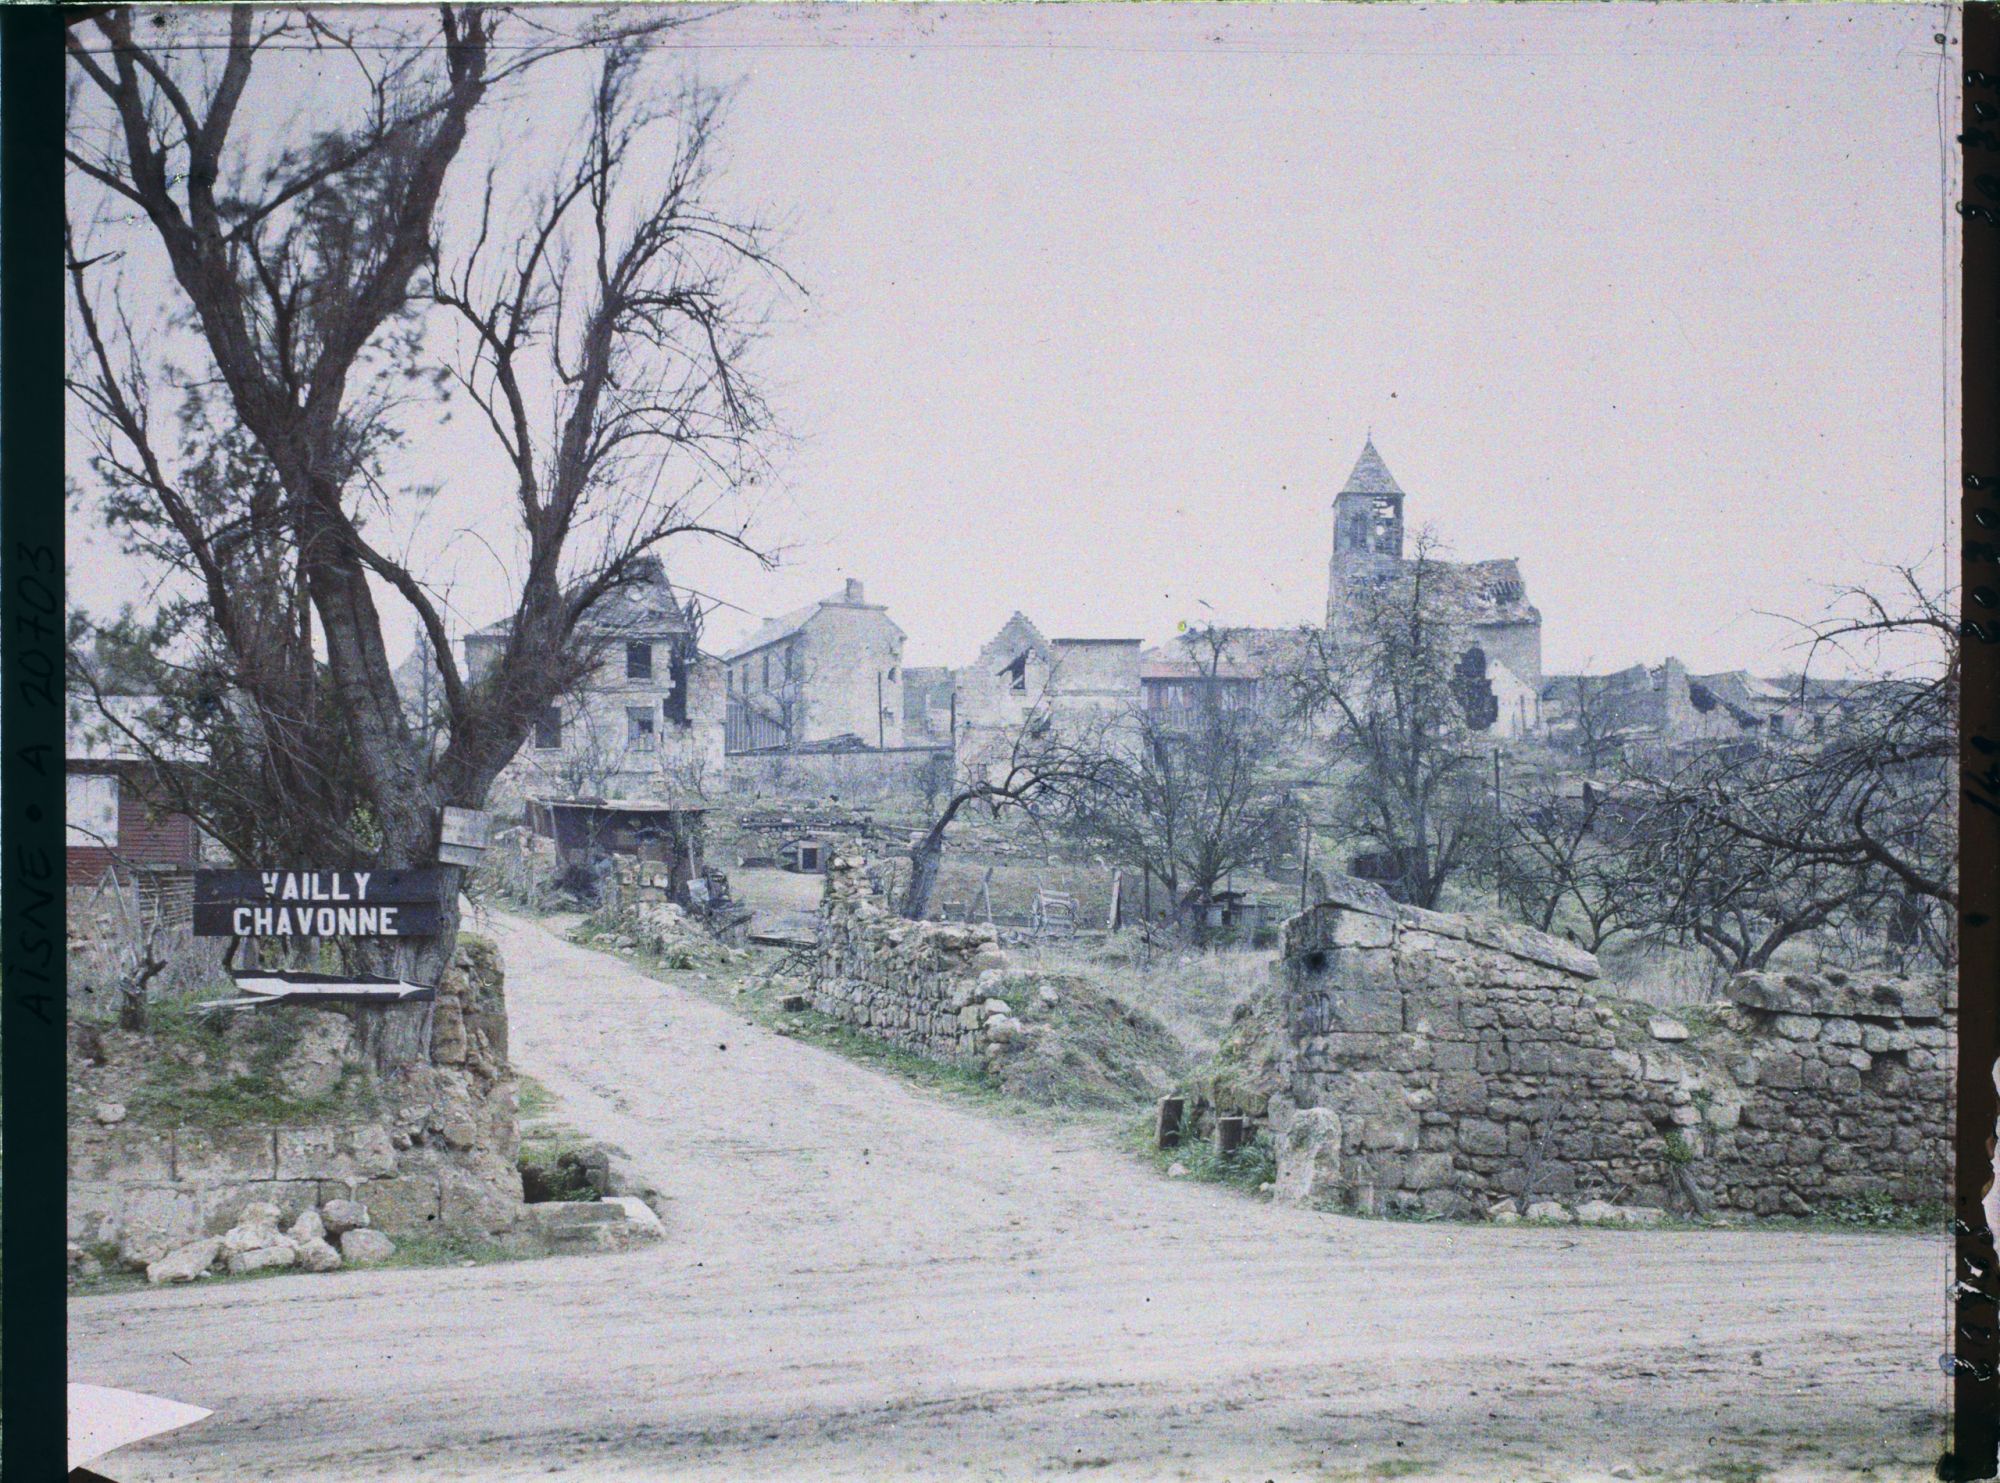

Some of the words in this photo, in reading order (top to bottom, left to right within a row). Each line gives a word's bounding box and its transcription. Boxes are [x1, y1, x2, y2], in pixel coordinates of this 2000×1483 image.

[17, 542, 56, 708] 20703
[16, 744, 52, 776] A
[262, 872, 370, 900] VAILLY
[233, 907, 398, 936] CHAVONNE
